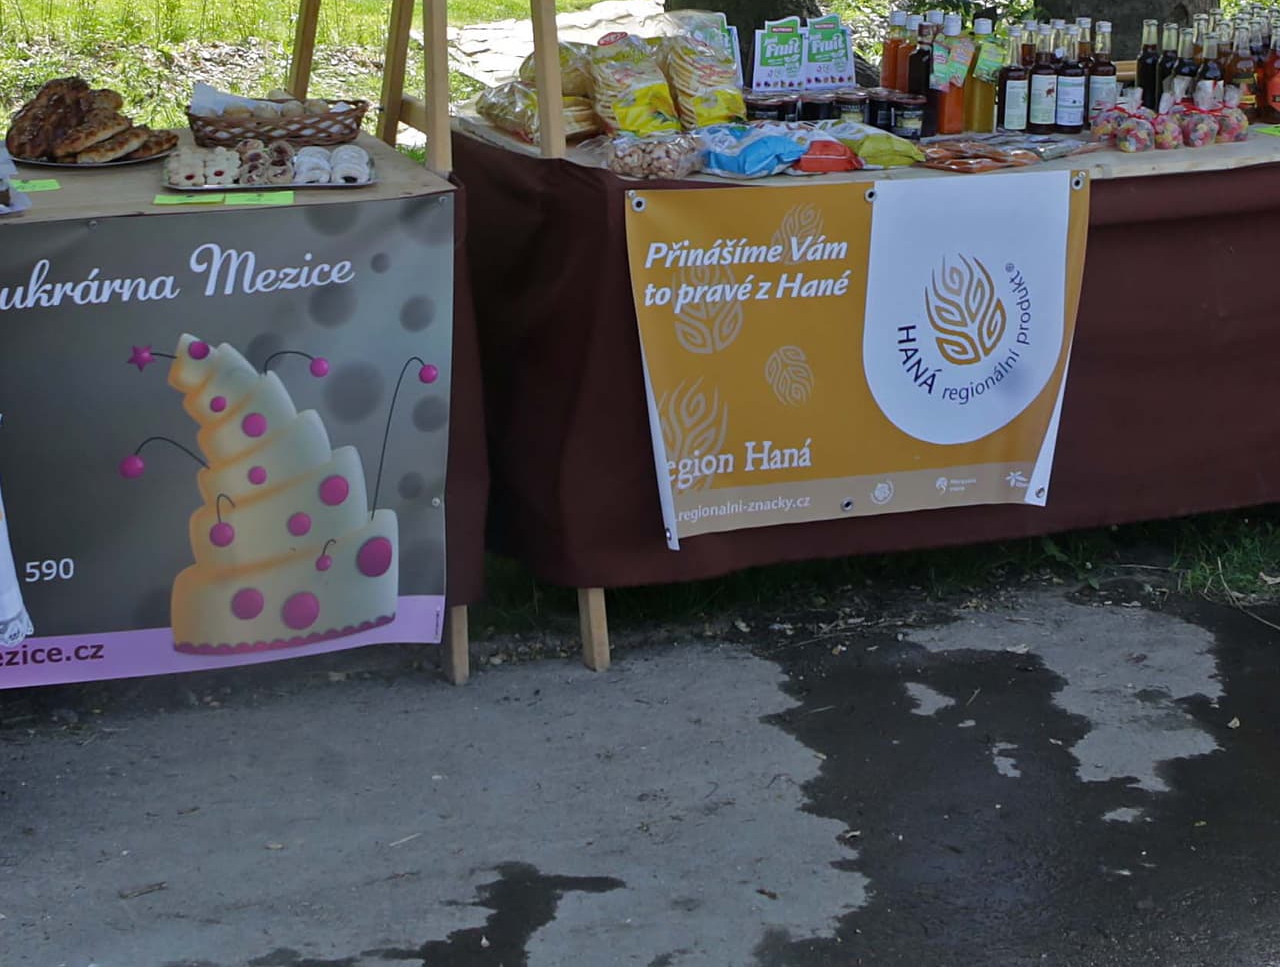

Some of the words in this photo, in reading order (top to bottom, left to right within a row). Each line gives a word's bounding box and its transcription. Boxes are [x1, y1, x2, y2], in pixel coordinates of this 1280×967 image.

[765, 37, 800, 57] Fruit
[812, 33, 845, 53] Fruit
[644, 238, 783, 268] Přinášíme
[790, 235, 848, 262] Vám
[189, 243, 355, 296] Mezice
[644, 283, 671, 306] to
[673, 274, 755, 314] pravé
[755, 282, 772, 300] z
[776, 270, 852, 299] Hané
[897, 325, 942, 395] HANÁ
[942, 348, 1020, 405] regionální
[744, 437, 812, 471] Haná
[25, 558, 74, 582] 590
